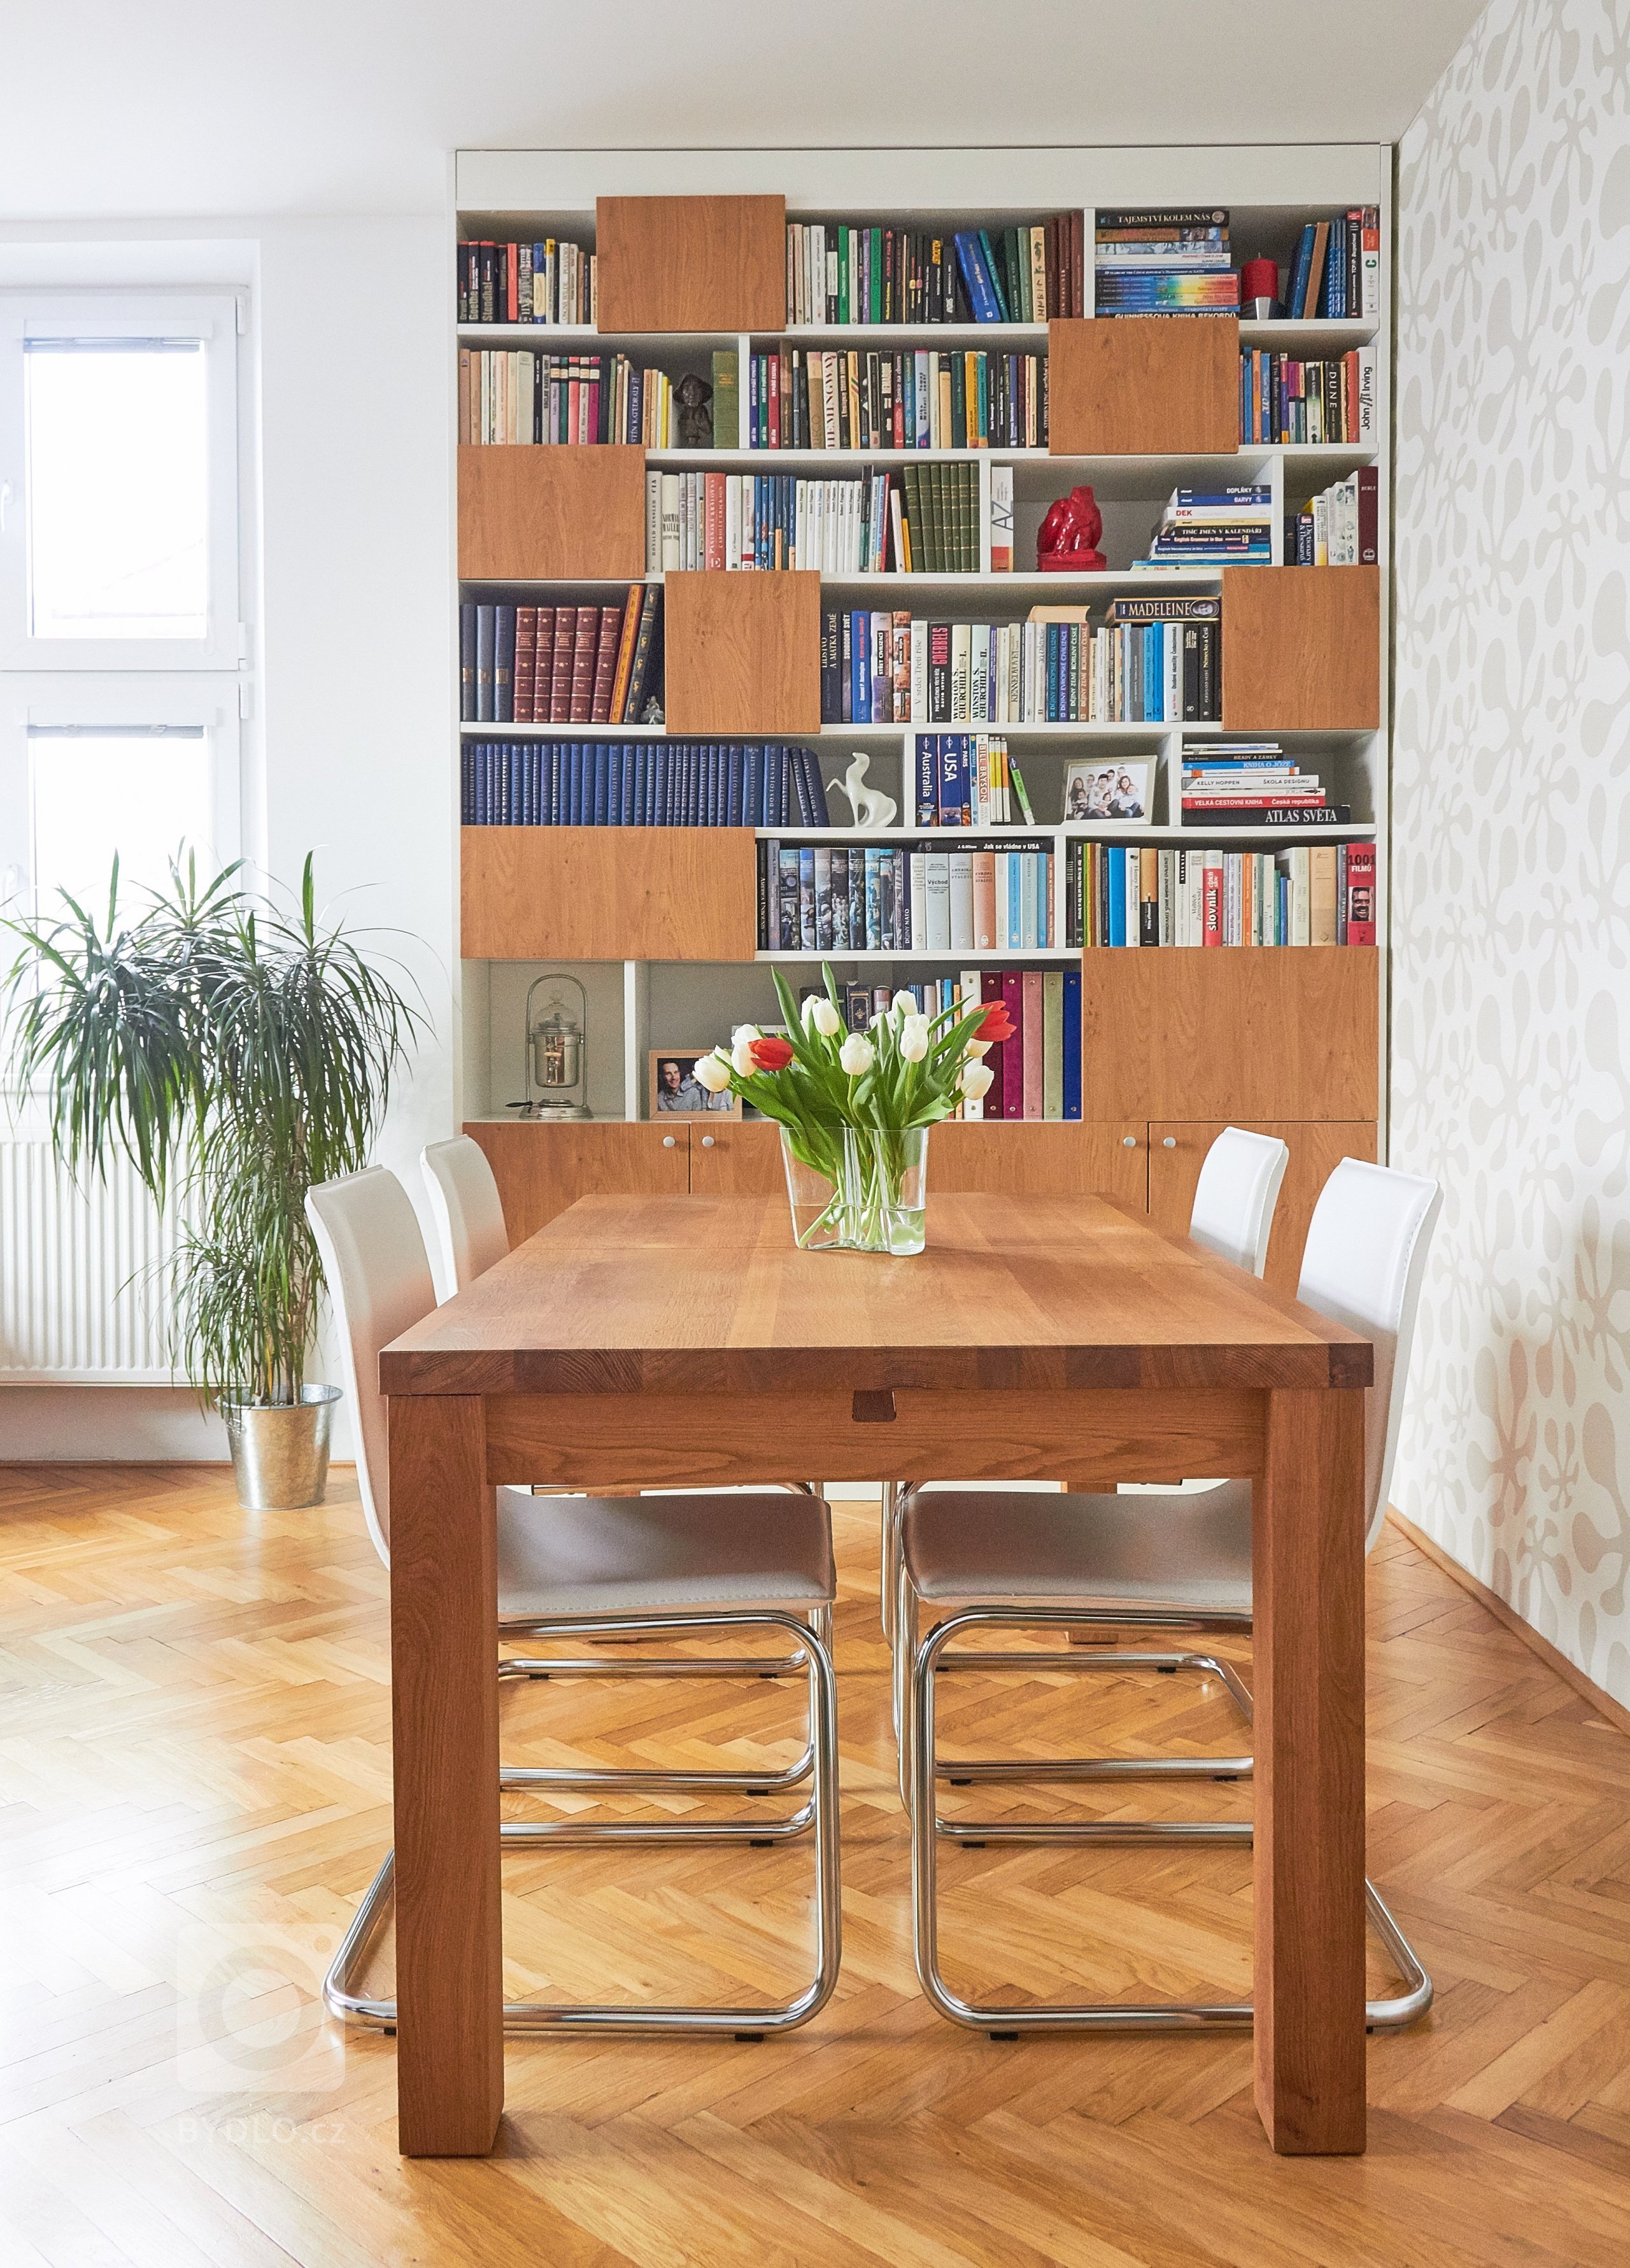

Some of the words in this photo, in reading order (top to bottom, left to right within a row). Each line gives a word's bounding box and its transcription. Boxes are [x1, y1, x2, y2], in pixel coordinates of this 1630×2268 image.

[1117, 213, 1162, 224] TAJEMSTVÍ
[1163, 213, 1192, 224] KOLEM
[1194, 211, 1211, 223] NÁS
[469, 290, 479, 320] Goethe
[482, 281, 493, 322] Stendhal
[1329, 371, 1338, 409] DUNE
[1361, 367, 1373, 392] Irving
[824, 355, 837, 448] HEMINGWAY
[1361, 408, 1371, 430] John
[991, 500, 1014, 530] AZ
[1129, 602, 1190, 616] MADELEINE
[827, 613, 837, 633] ZEMĚ
[842, 614, 851, 628] SVĚT
[932, 627, 947, 665] GOEBBELS
[953, 668, 959, 676] S.
[972, 667, 980, 676] S.
[979, 745, 988, 763] BILL
[922, 751, 933, 797] Australia
[944, 753, 958, 782] USA
[804, 758, 816, 809] DOSTOJEVSKIJ
[980, 765, 989, 802] BRYSON
[1271, 797, 1291, 805] Česká
[1291, 798, 1320, 806] republika
[1265, 809, 1300, 823] ATLAS
[1302, 808, 1338, 822] SVĚTA
[1347, 854, 1376, 865] 1001
[1351, 863, 1372, 872] FILMŮ
